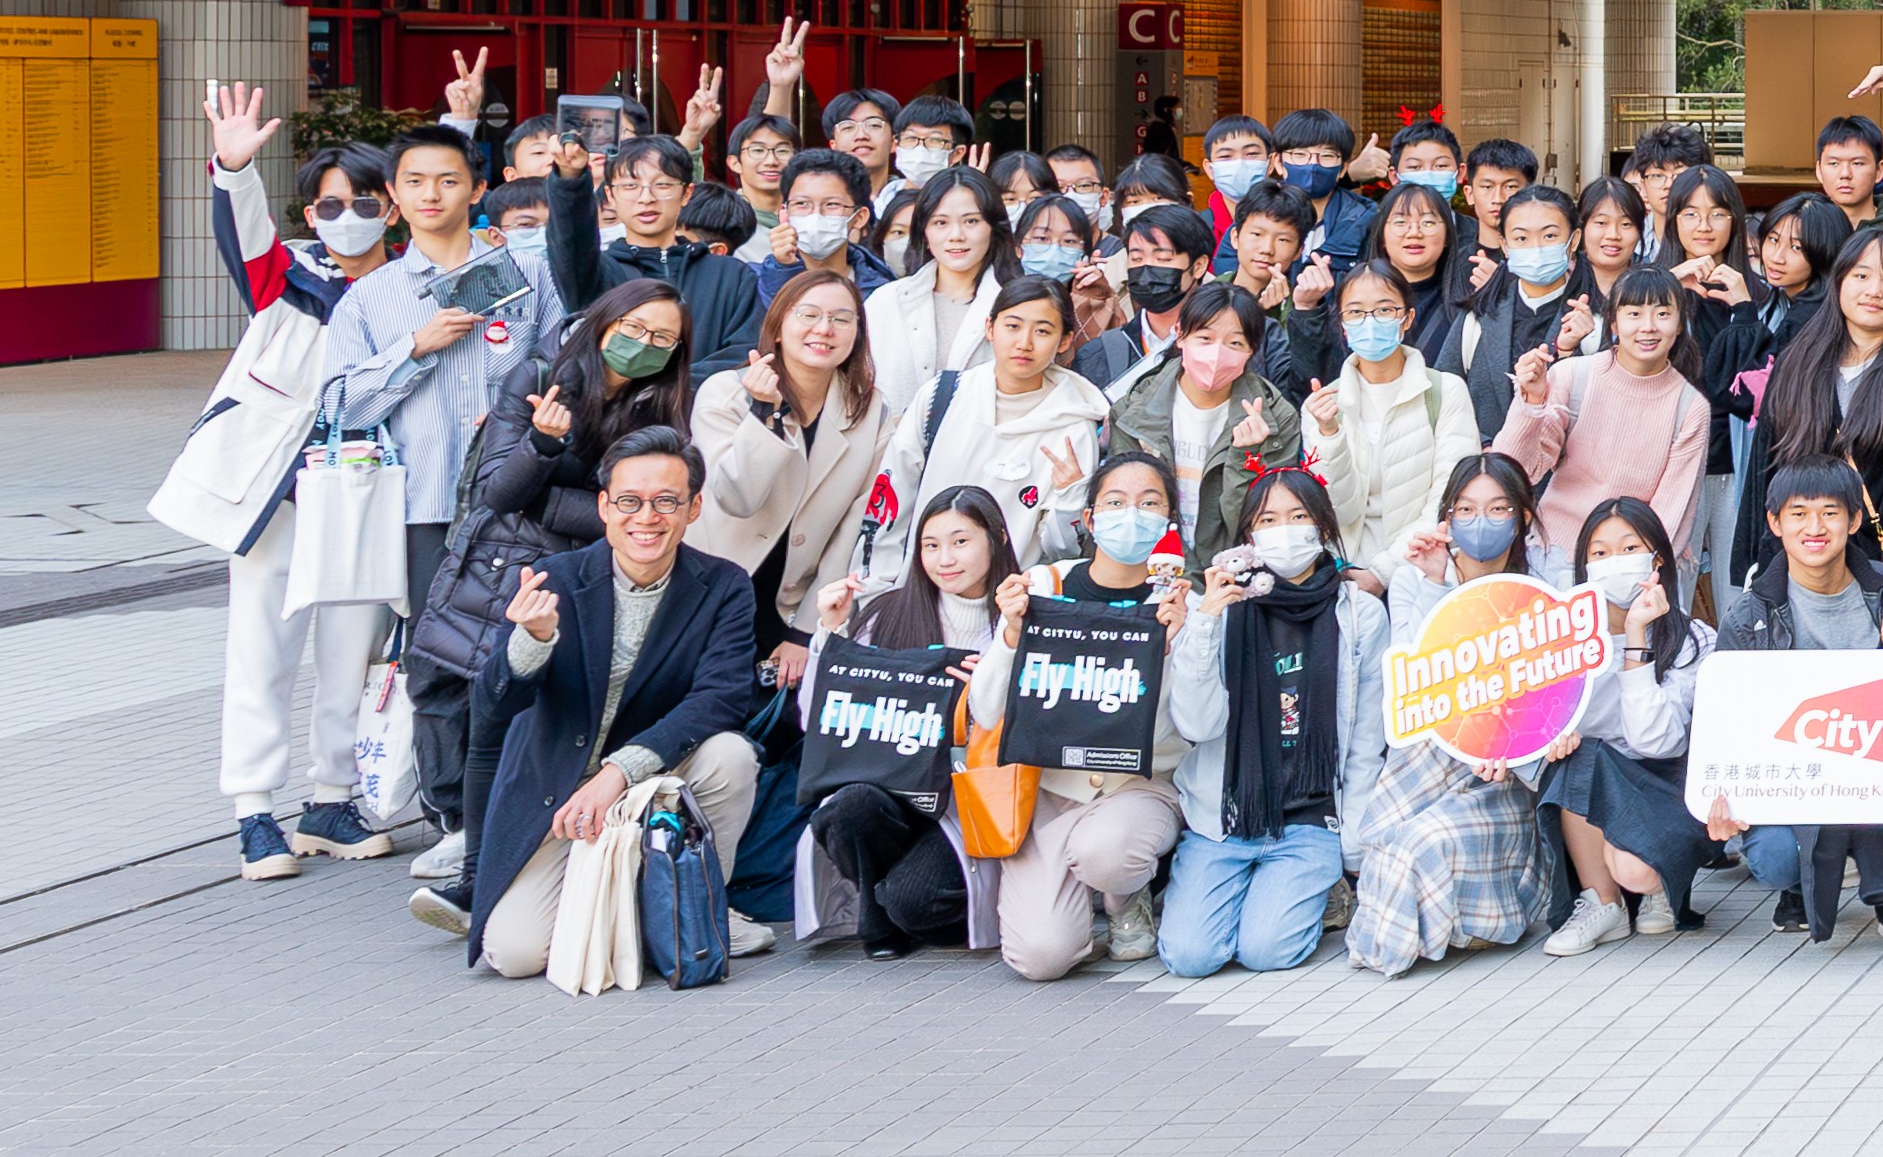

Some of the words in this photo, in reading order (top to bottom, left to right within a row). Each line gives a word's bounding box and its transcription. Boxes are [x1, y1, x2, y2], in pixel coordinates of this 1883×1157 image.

[1128, 9, 1155, 43] C
[1168, 10, 1180, 43] C
[1137, 73, 1147, 84] A
[1137, 92, 1147, 103] B
[1027, 625, 1040, 635] AT
[1042, 628, 1087, 641] CITYU,
[1091, 630, 1118, 641] YOU
[1122, 632, 1150, 642] CAN
[1395, 594, 1594, 698] Innovating
[829, 665, 847, 675] AT
[848, 668, 893, 682] CITYU,
[898, 672, 924, 684] YOU
[927, 677, 955, 688] CAN
[1019, 652, 1070, 710] Fly
[1070, 655, 1141, 713] High
[1396, 694, 1452, 736] into
[1457, 674, 1504, 712] the
[1509, 638, 1600, 693] Future
[820, 690, 868, 748] Fly
[869, 696, 943, 756] High
[1703, 762, 1822, 781] 香港城市大學
[1701, 784, 1734, 797] City
[1735, 784, 1809, 800] University
[1811, 783, 1829, 797] of
[1831, 784, 1868, 800] Hong
